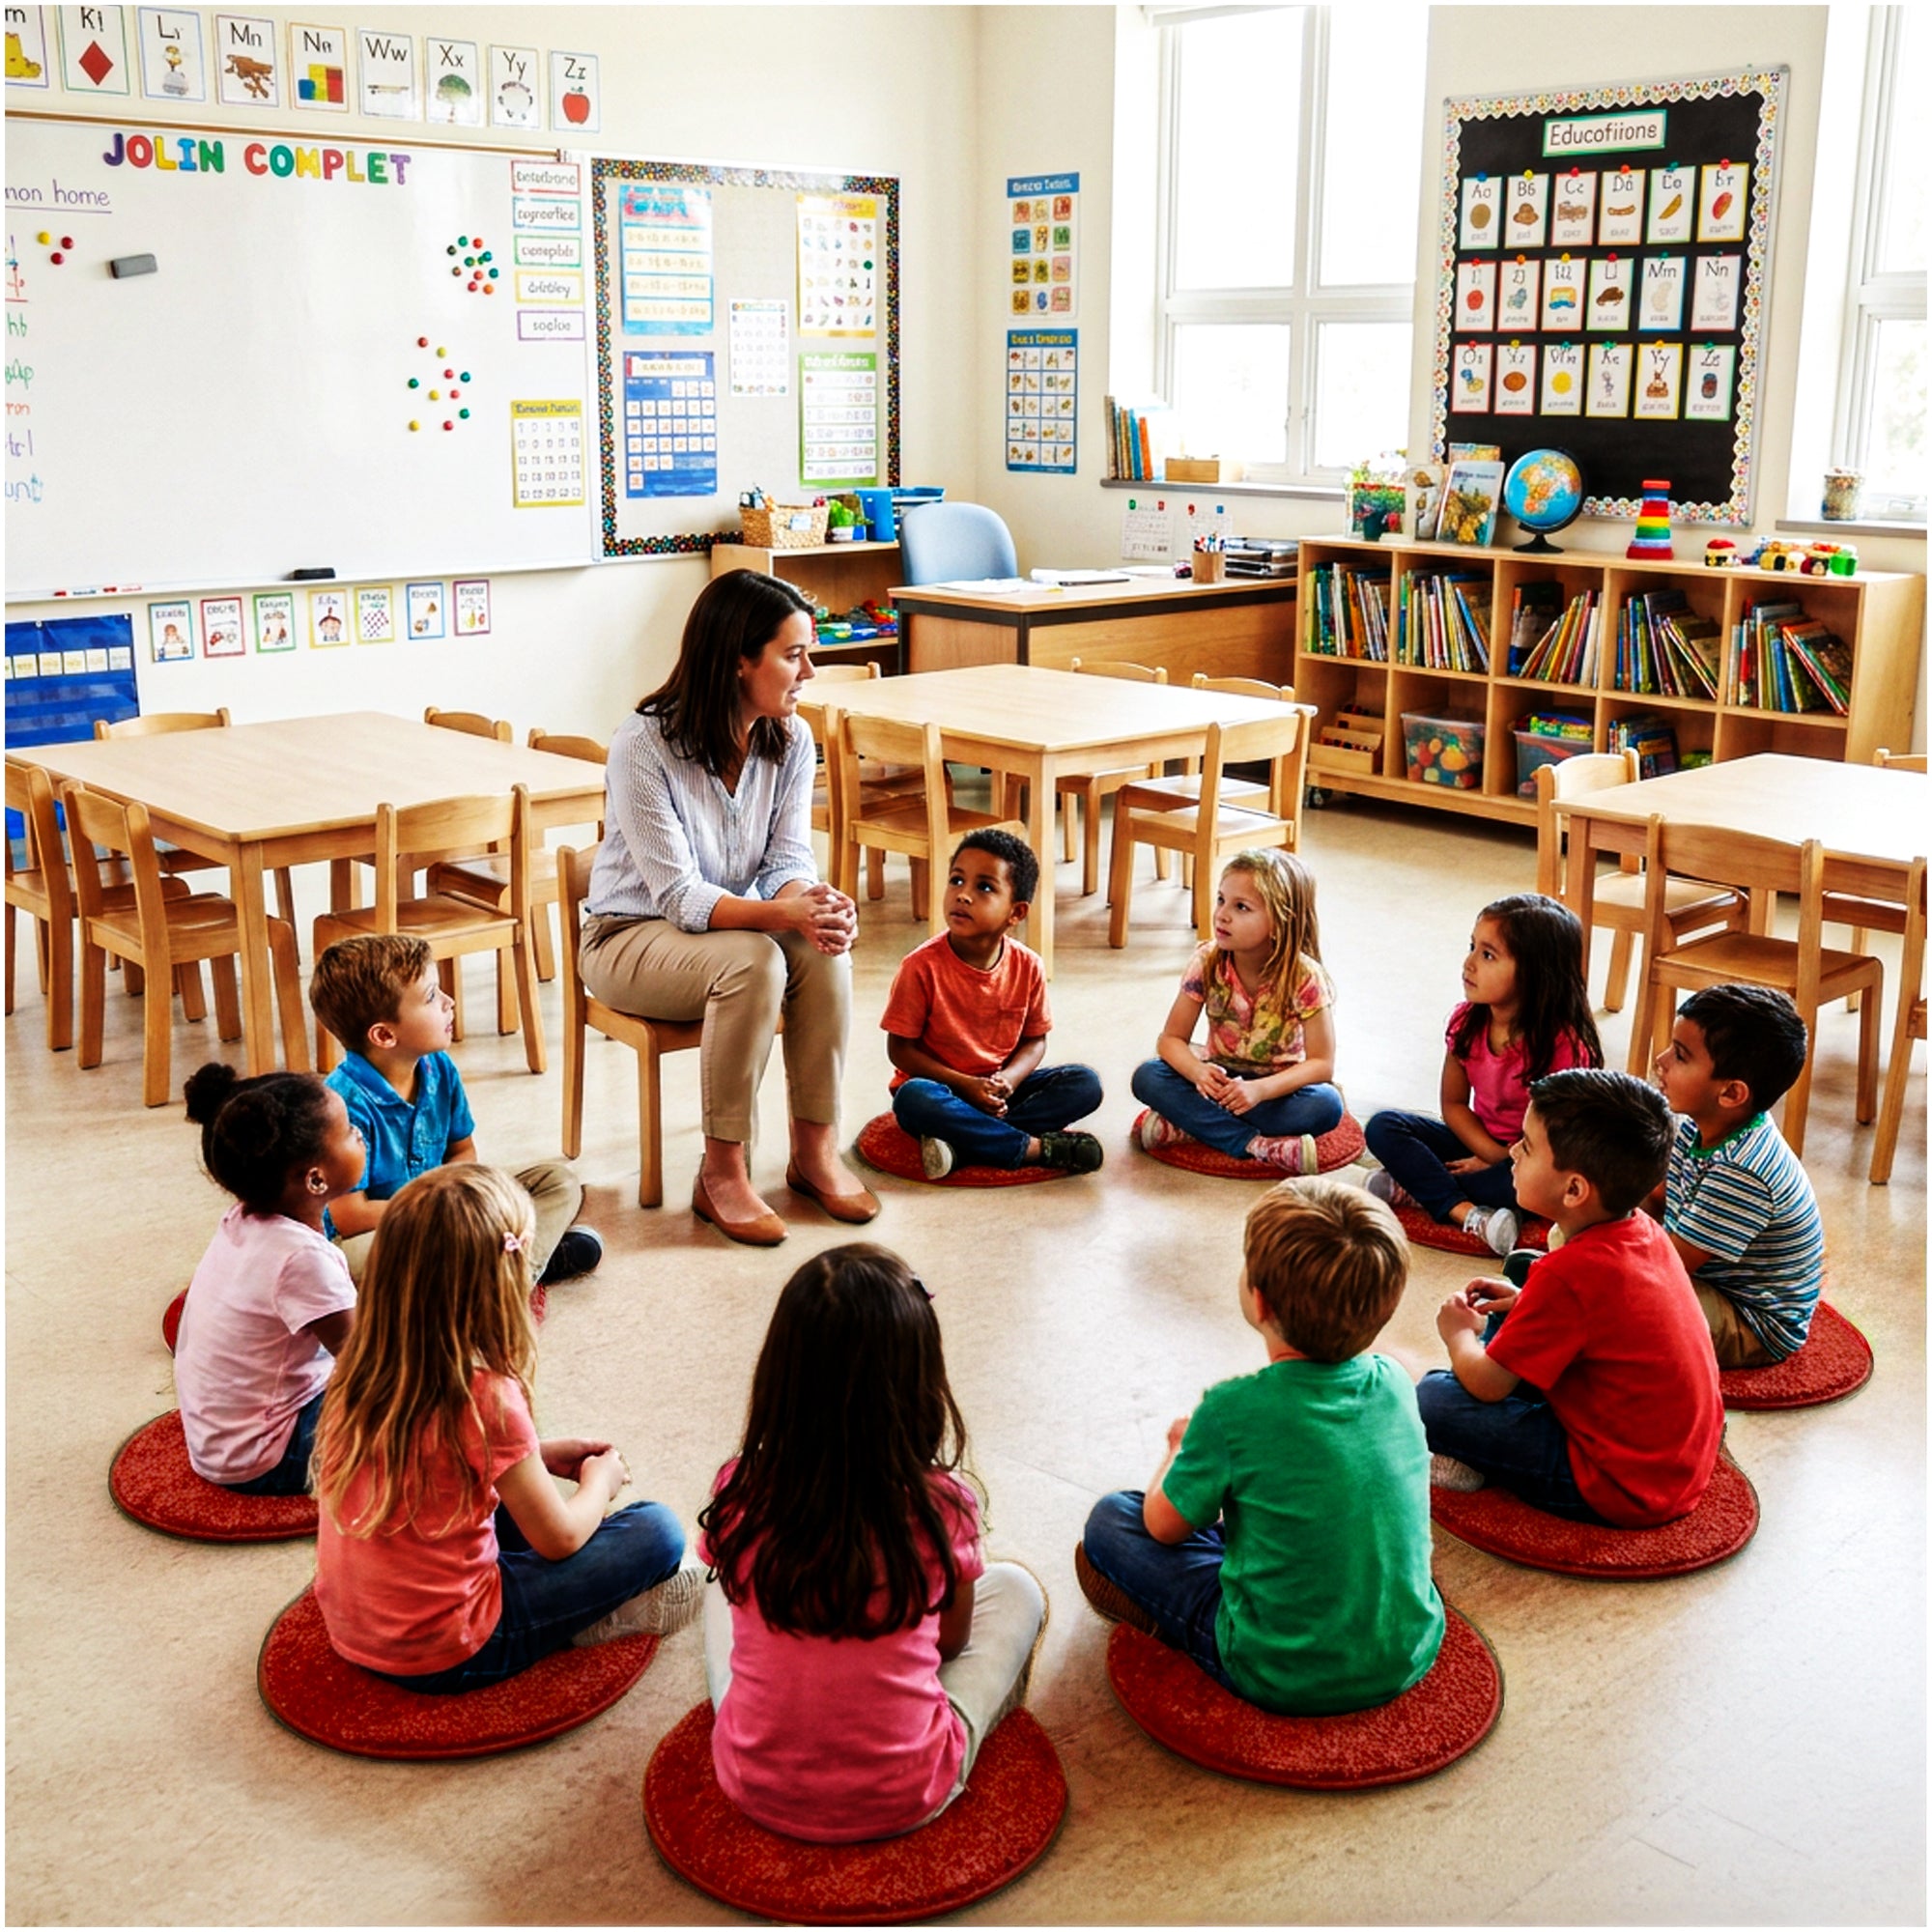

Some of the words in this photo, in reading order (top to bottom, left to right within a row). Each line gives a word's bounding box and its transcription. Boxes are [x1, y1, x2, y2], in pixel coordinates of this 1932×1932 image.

[364, 37, 408, 62] Ww
[439, 44, 464, 68] Xx
[502, 51, 526, 81] Yy
[102, 132, 225, 173] JOLIN
[244, 142, 412, 185] COMPLET
[52, 178, 110, 207] home
